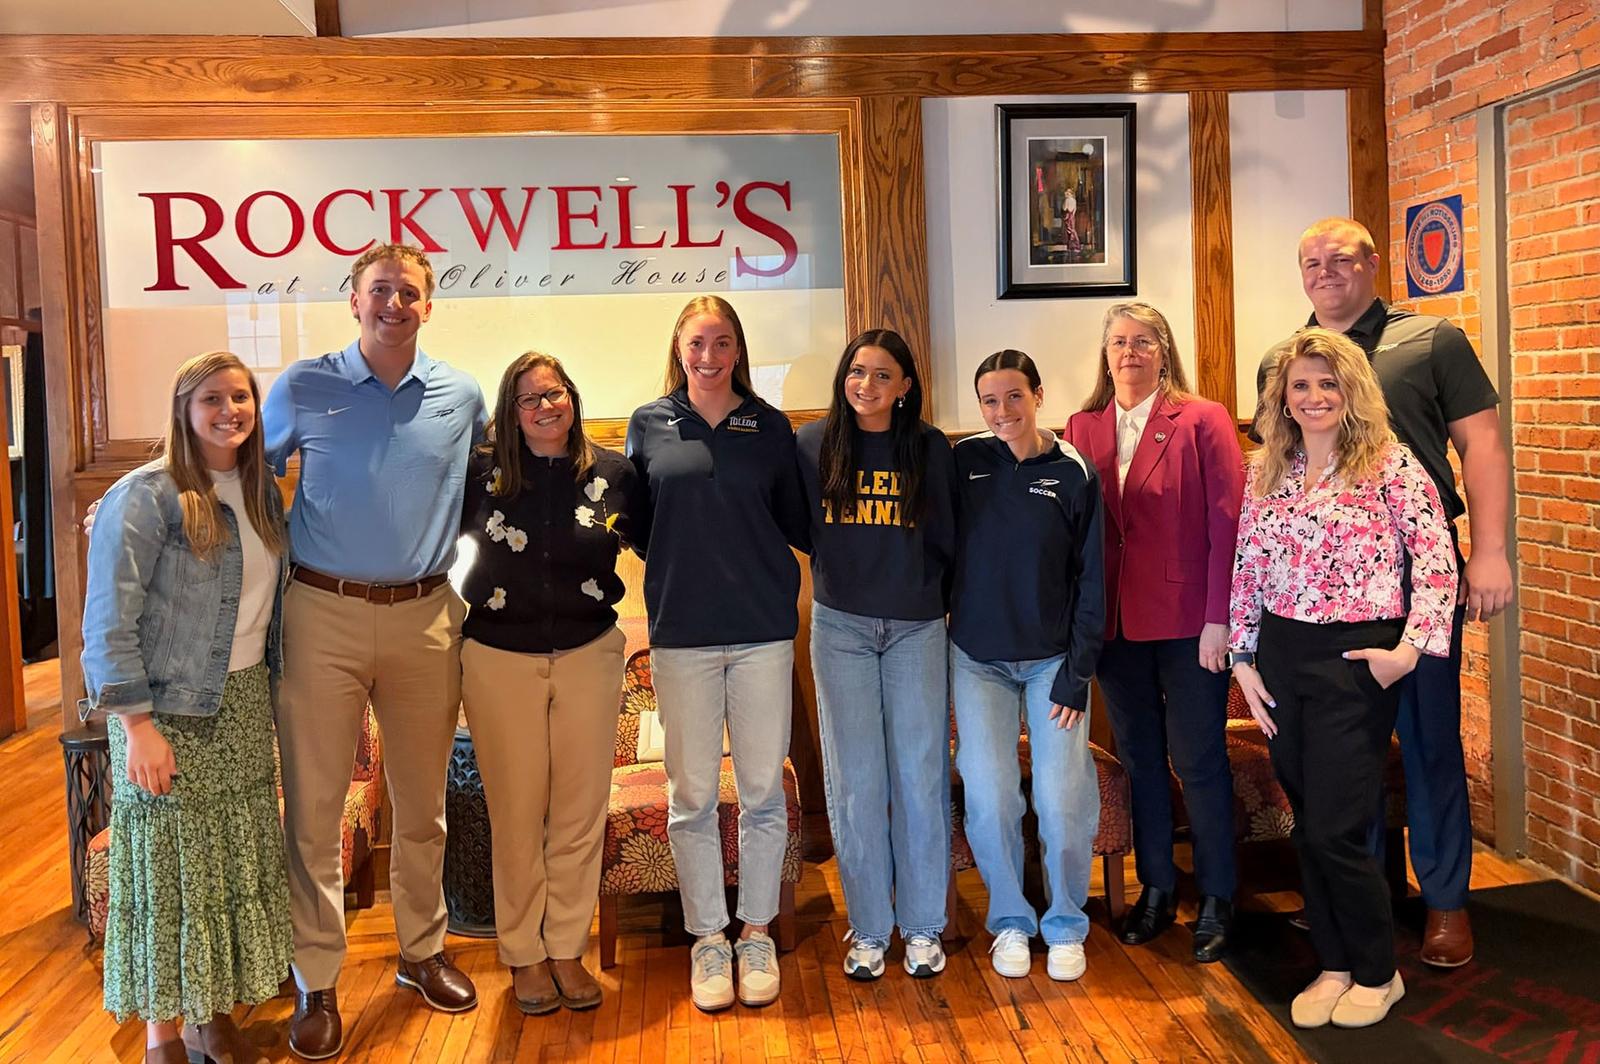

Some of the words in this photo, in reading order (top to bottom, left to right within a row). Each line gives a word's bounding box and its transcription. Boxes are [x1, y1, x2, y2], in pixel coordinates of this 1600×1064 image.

[137, 180, 799, 292] ROCKWELL'S
[257, 276, 301, 295] at
[439, 263, 576, 290] Oliver
[611, 259, 727, 286] House
[729, 416, 758, 428] TOLEDO
[1028, 487, 1057, 498] SOCCER
[822, 498, 916, 529] TENNI
